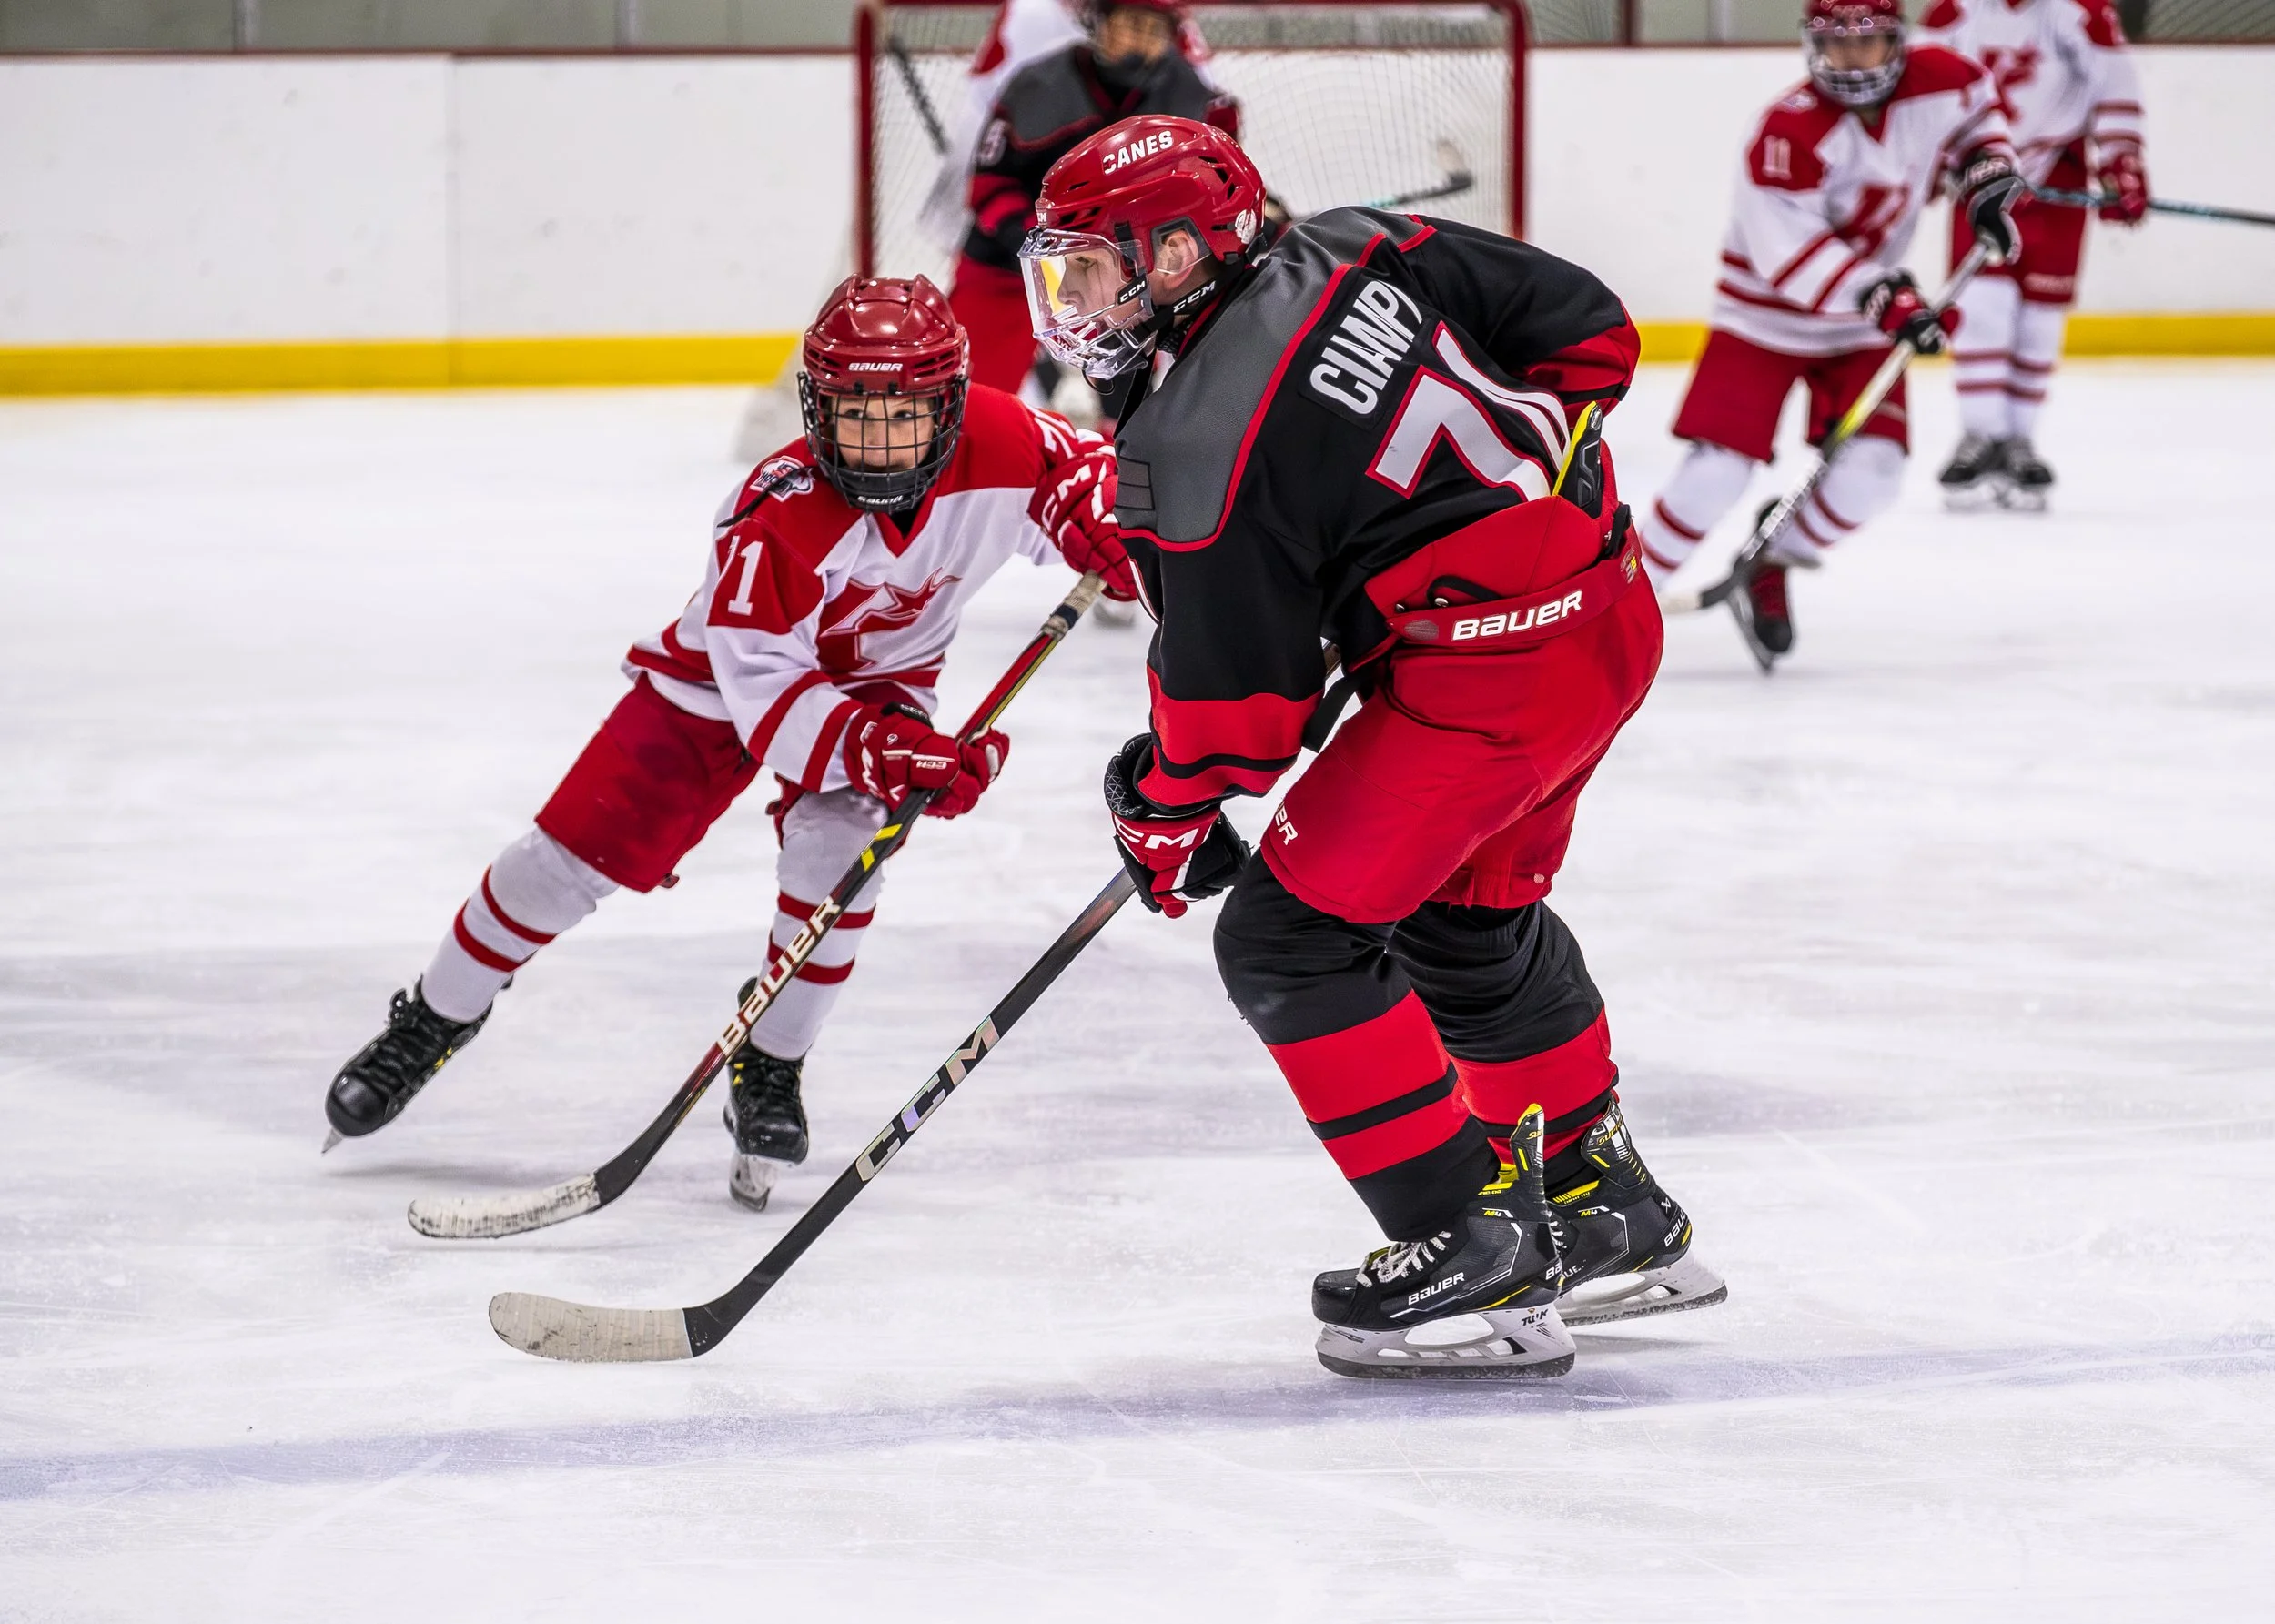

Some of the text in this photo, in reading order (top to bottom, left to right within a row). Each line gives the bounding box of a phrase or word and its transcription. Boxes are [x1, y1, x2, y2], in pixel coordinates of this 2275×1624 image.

[1103, 130, 1173, 175] CANES
[1763, 136, 1791, 180] 11
[1119, 280, 1146, 303] CCM
[1173, 280, 1216, 313] CCM
[848, 362, 903, 372] BAUER
[1451, 590, 1582, 641] BAUER
[1114, 814, 1199, 849] CM
[717, 896, 842, 1058] BAUER
[856, 1015, 1001, 1182] CCM
[1408, 1272, 1465, 1306] BAUER
